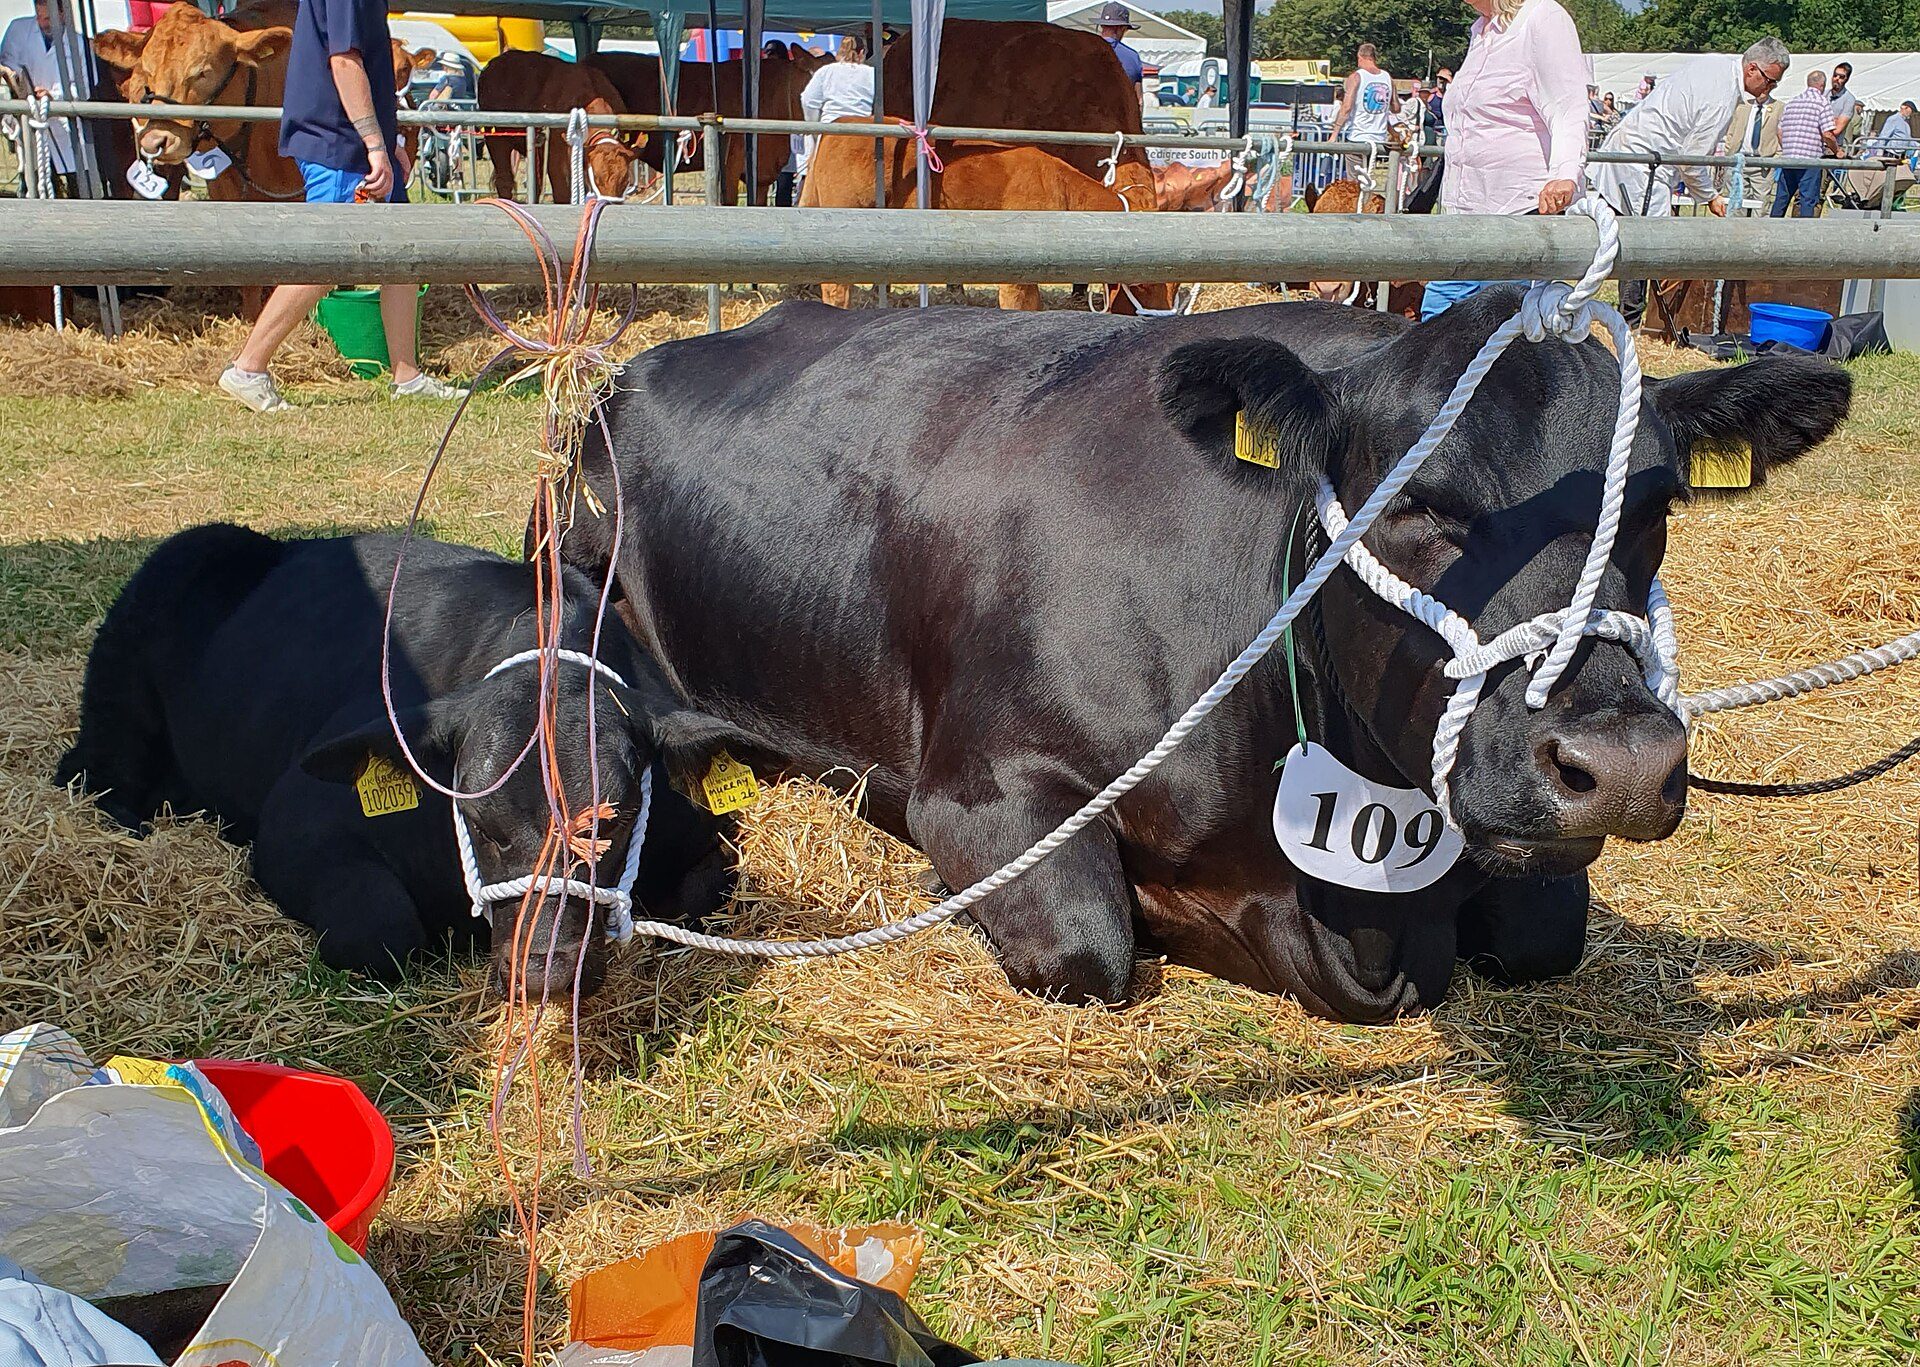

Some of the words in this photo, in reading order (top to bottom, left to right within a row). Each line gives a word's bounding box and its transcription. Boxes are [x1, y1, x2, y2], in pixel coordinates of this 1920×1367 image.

[1188, 149, 1218, 160] South
[363, 781, 413, 813] 102039
[708, 777, 749, 796] MURRAY
[1300, 791, 1445, 870] 109
